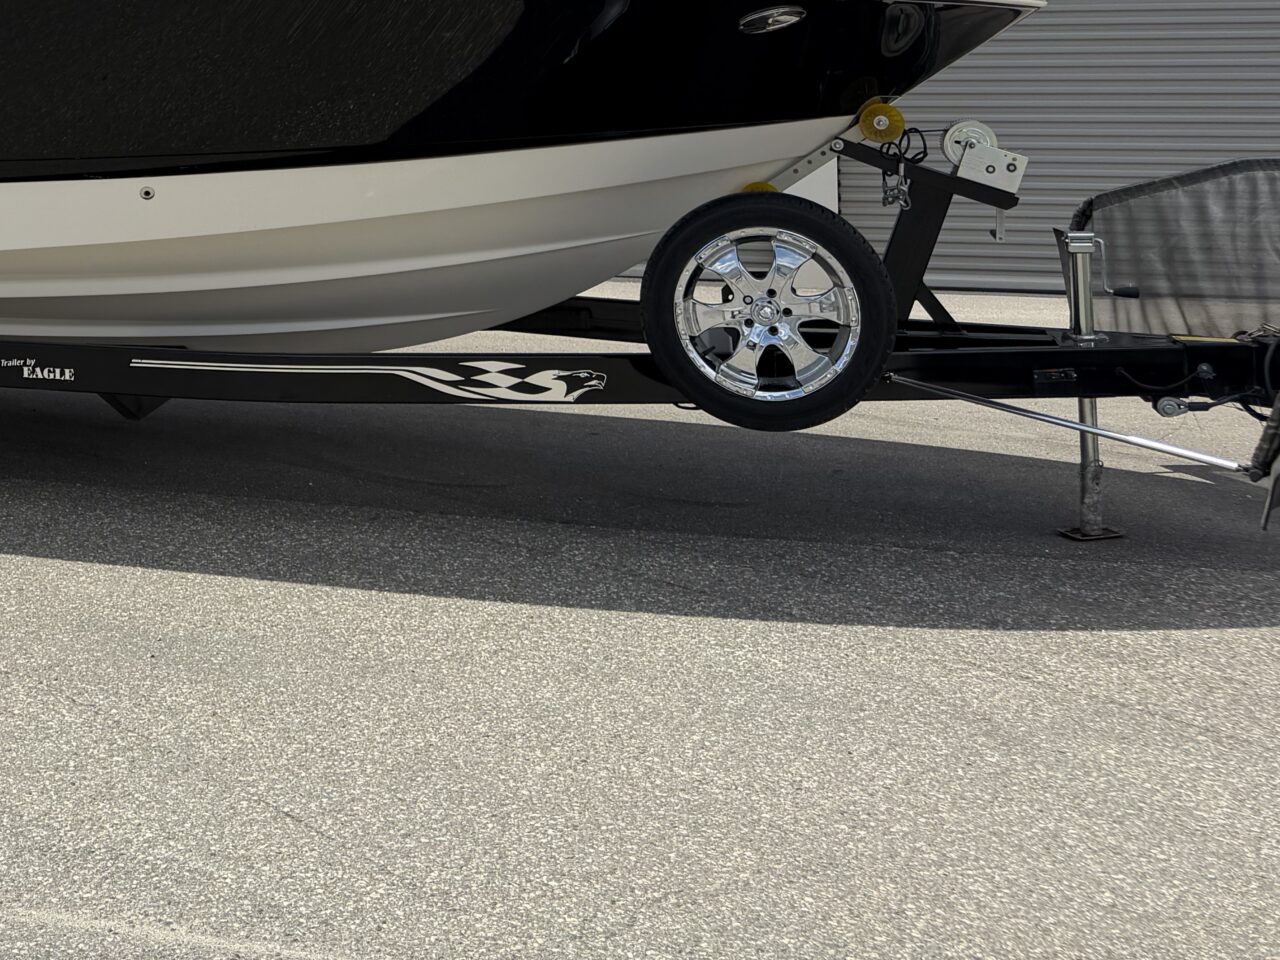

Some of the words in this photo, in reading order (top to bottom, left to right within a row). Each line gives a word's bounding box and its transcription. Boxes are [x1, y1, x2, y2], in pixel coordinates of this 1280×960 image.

[0, 358, 25, 367] Trailer
[26, 357, 36, 367] by
[22, 366, 75, 381] EAGLE
